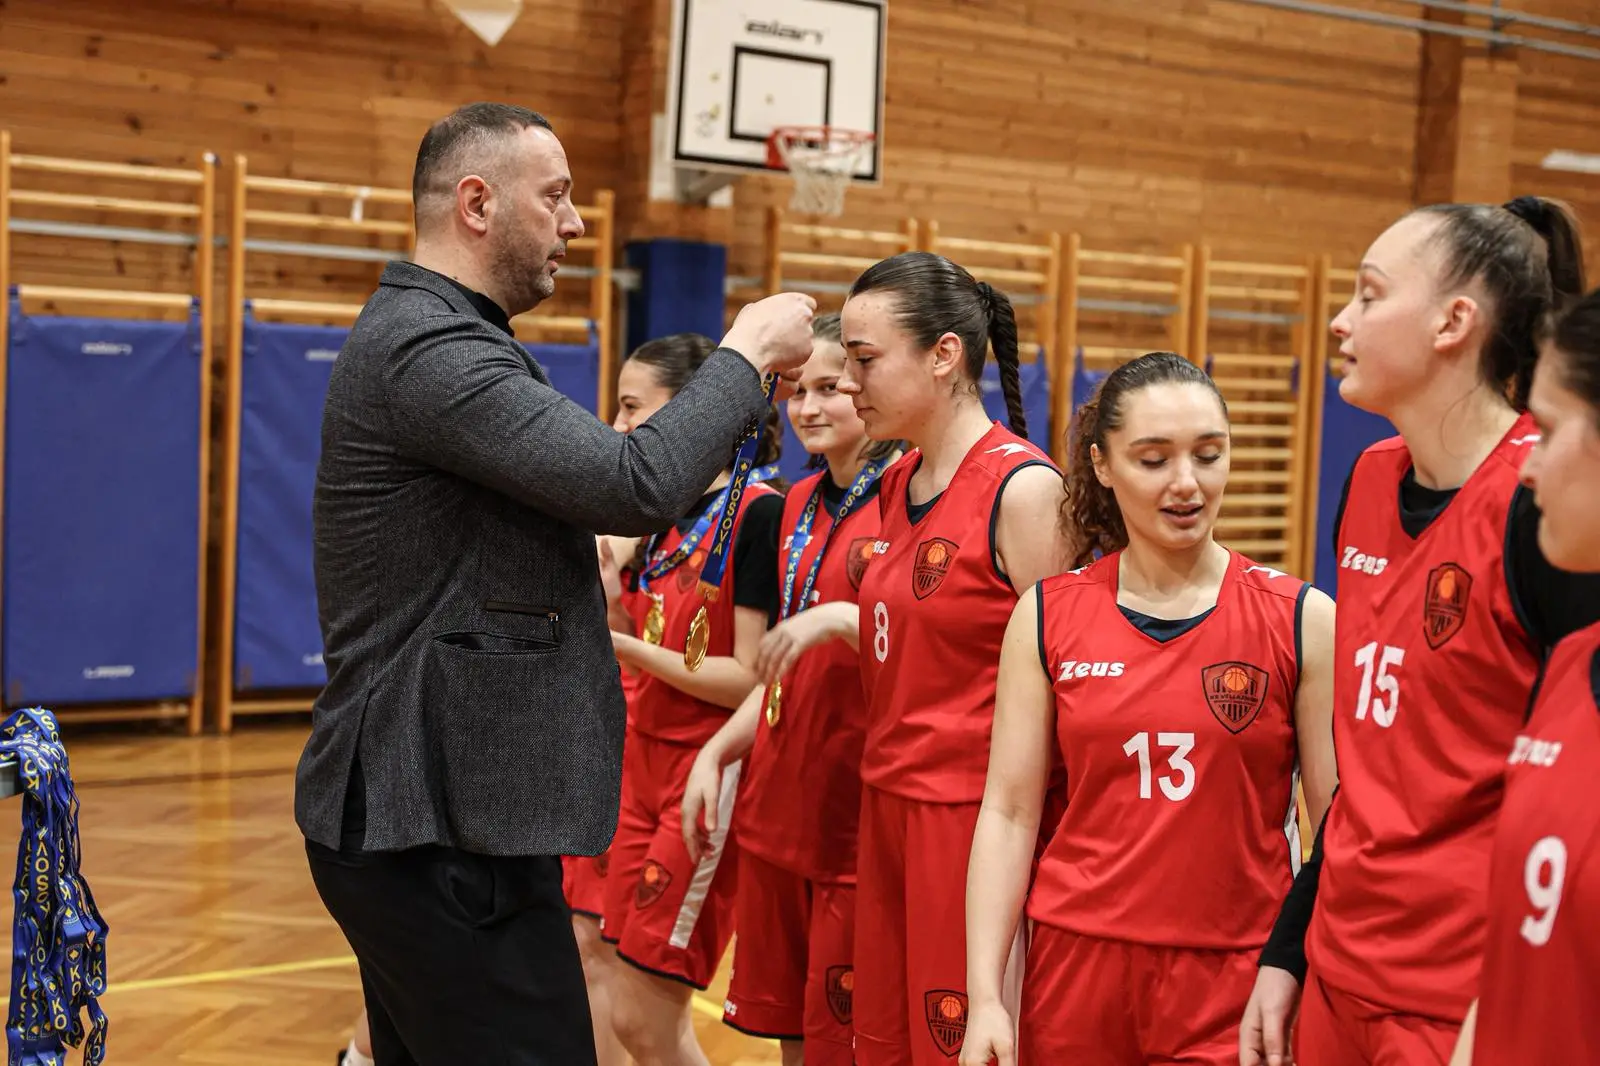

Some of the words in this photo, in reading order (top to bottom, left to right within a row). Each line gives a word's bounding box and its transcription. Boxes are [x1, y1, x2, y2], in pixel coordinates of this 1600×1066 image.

[713, 476, 745, 556] KOSOVA
[1340, 546, 1388, 576] Zeus
[874, 601, 889, 663] 8
[1058, 660, 1125, 682] Zeus
[1355, 641, 1405, 728] 15
[1122, 731, 1196, 801] 13
[1520, 835, 1567, 947] 9
